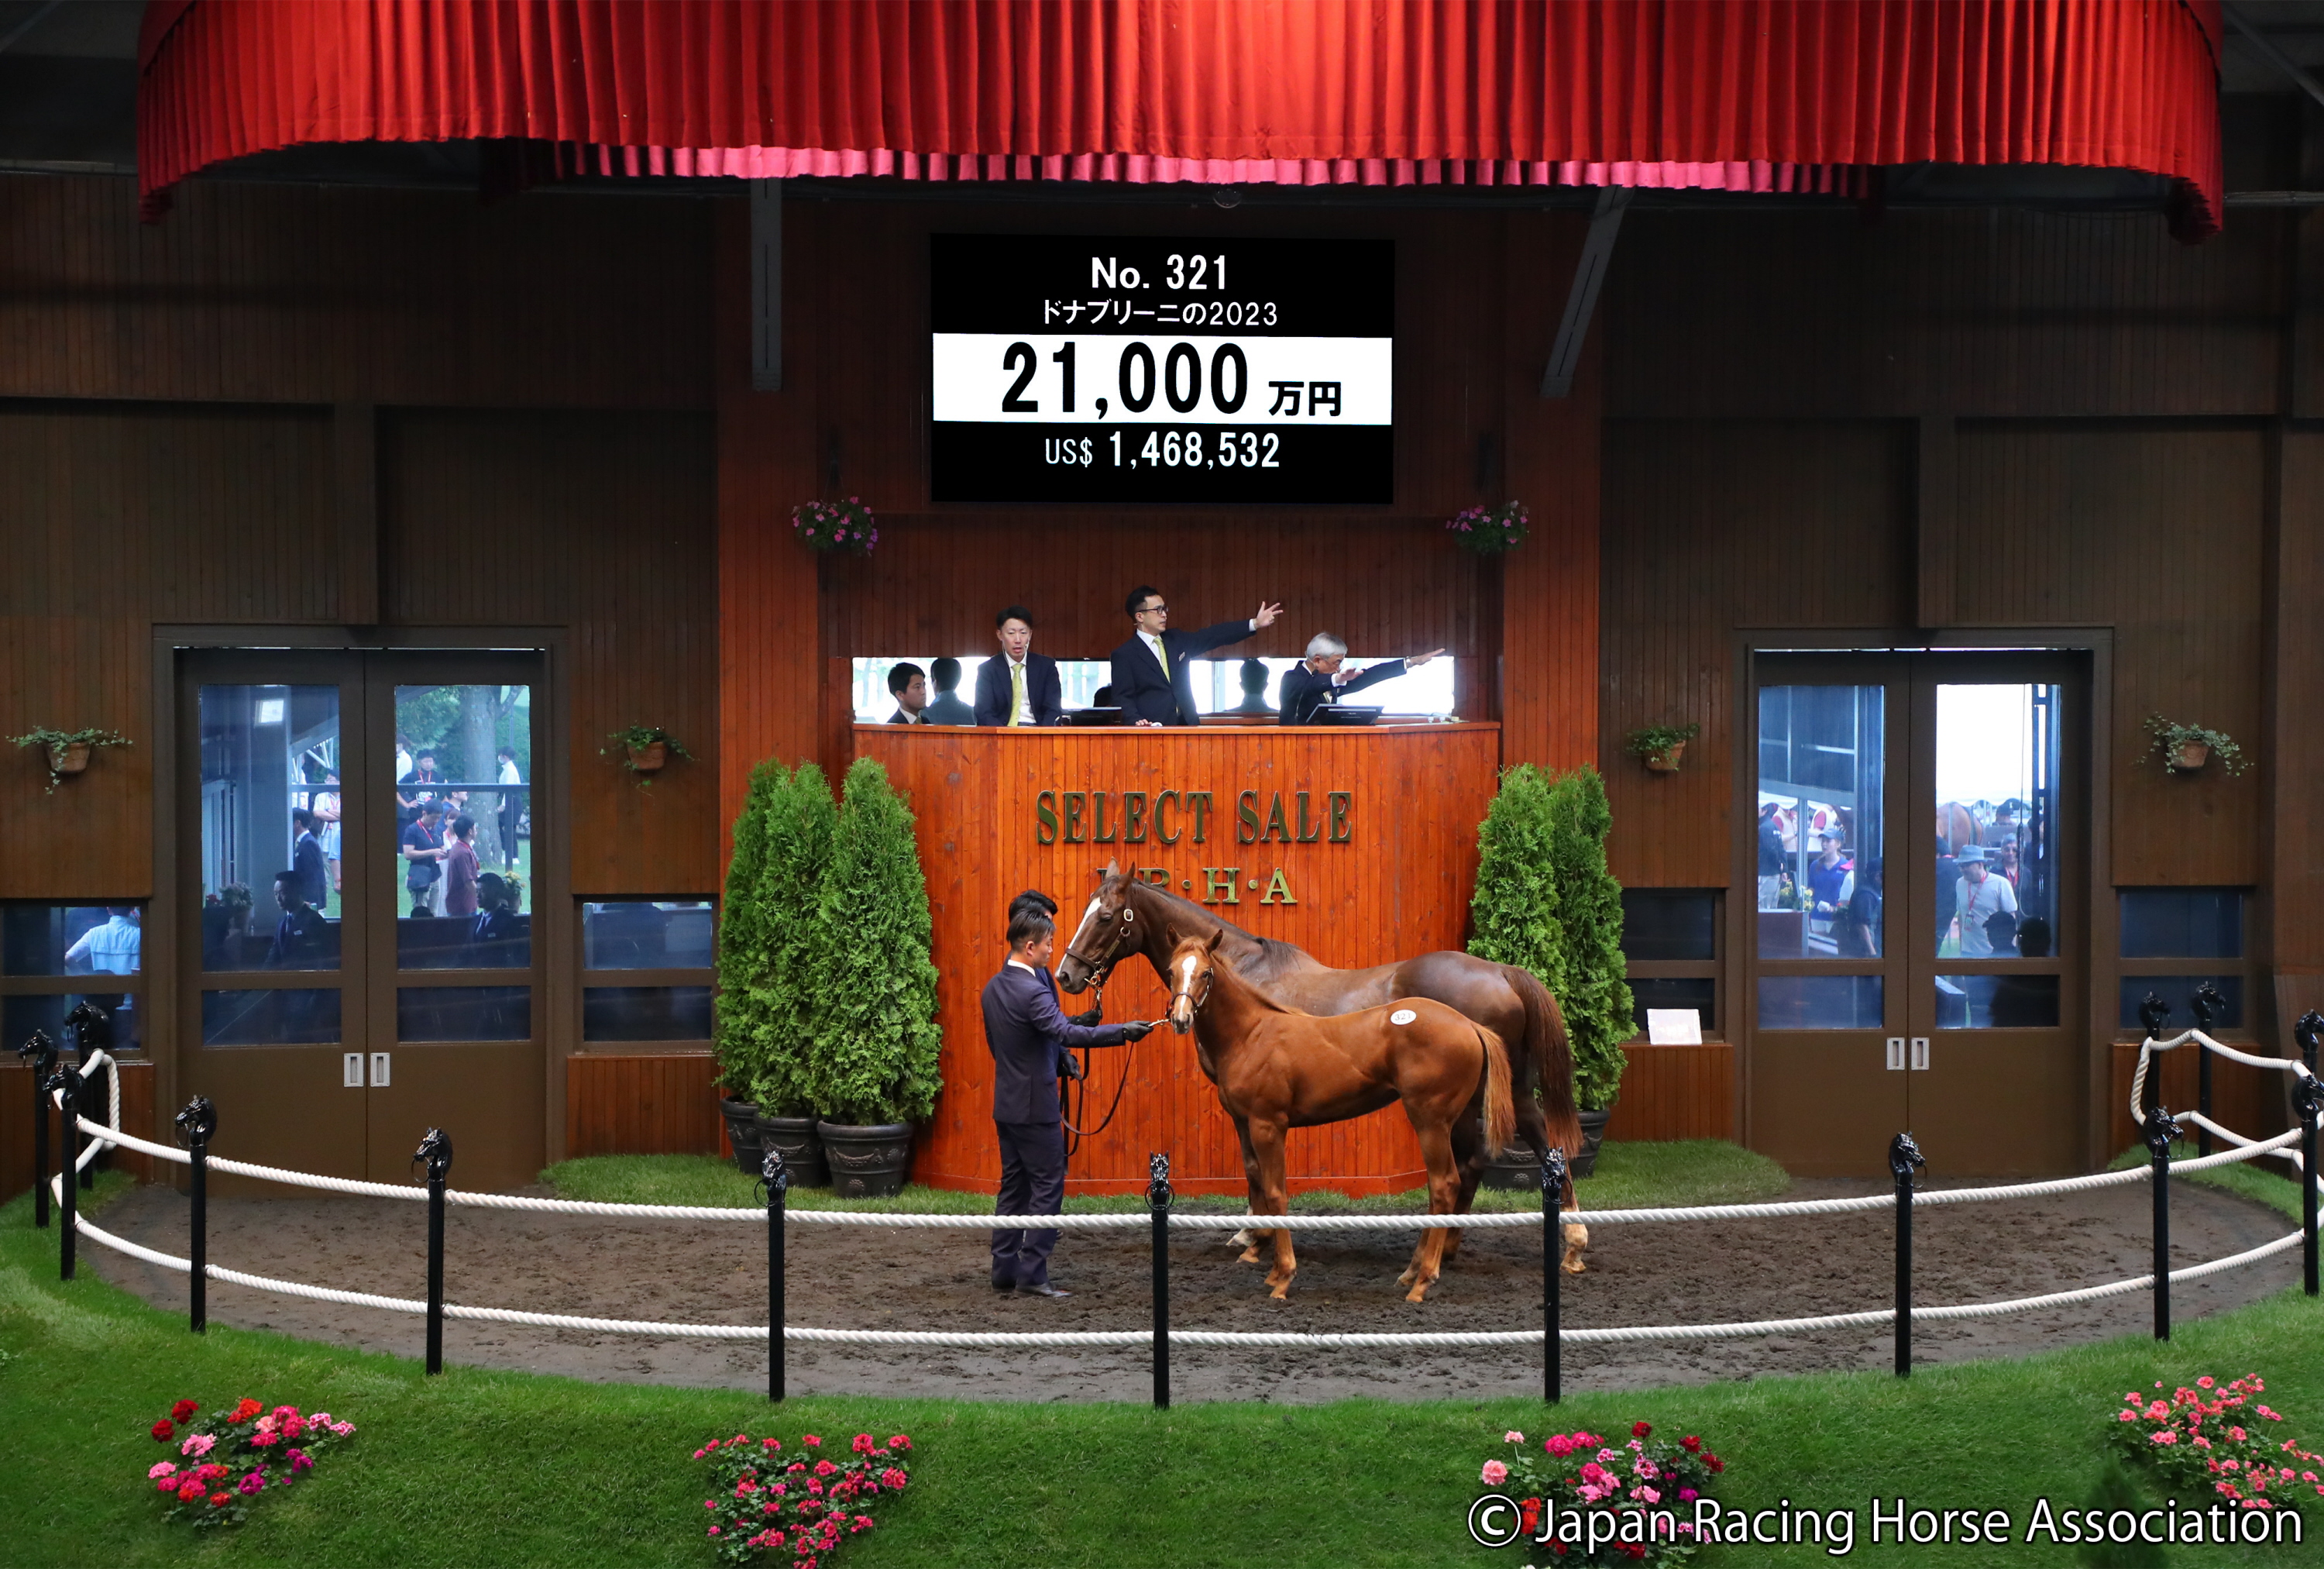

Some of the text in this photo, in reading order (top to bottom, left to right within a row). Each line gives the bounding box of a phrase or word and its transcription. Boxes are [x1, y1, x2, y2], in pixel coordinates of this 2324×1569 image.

[1092, 254, 1225, 290] No. 321
[1044, 298, 1278, 326] ドナブリーニの2023
[1002, 341, 1342, 420] 21,000 万円
[1045, 431, 1280, 470] US$ 1,468,532
[1036, 789, 1353, 845] SELECT SALE
[1394, 1013, 1411, 1021] 321
